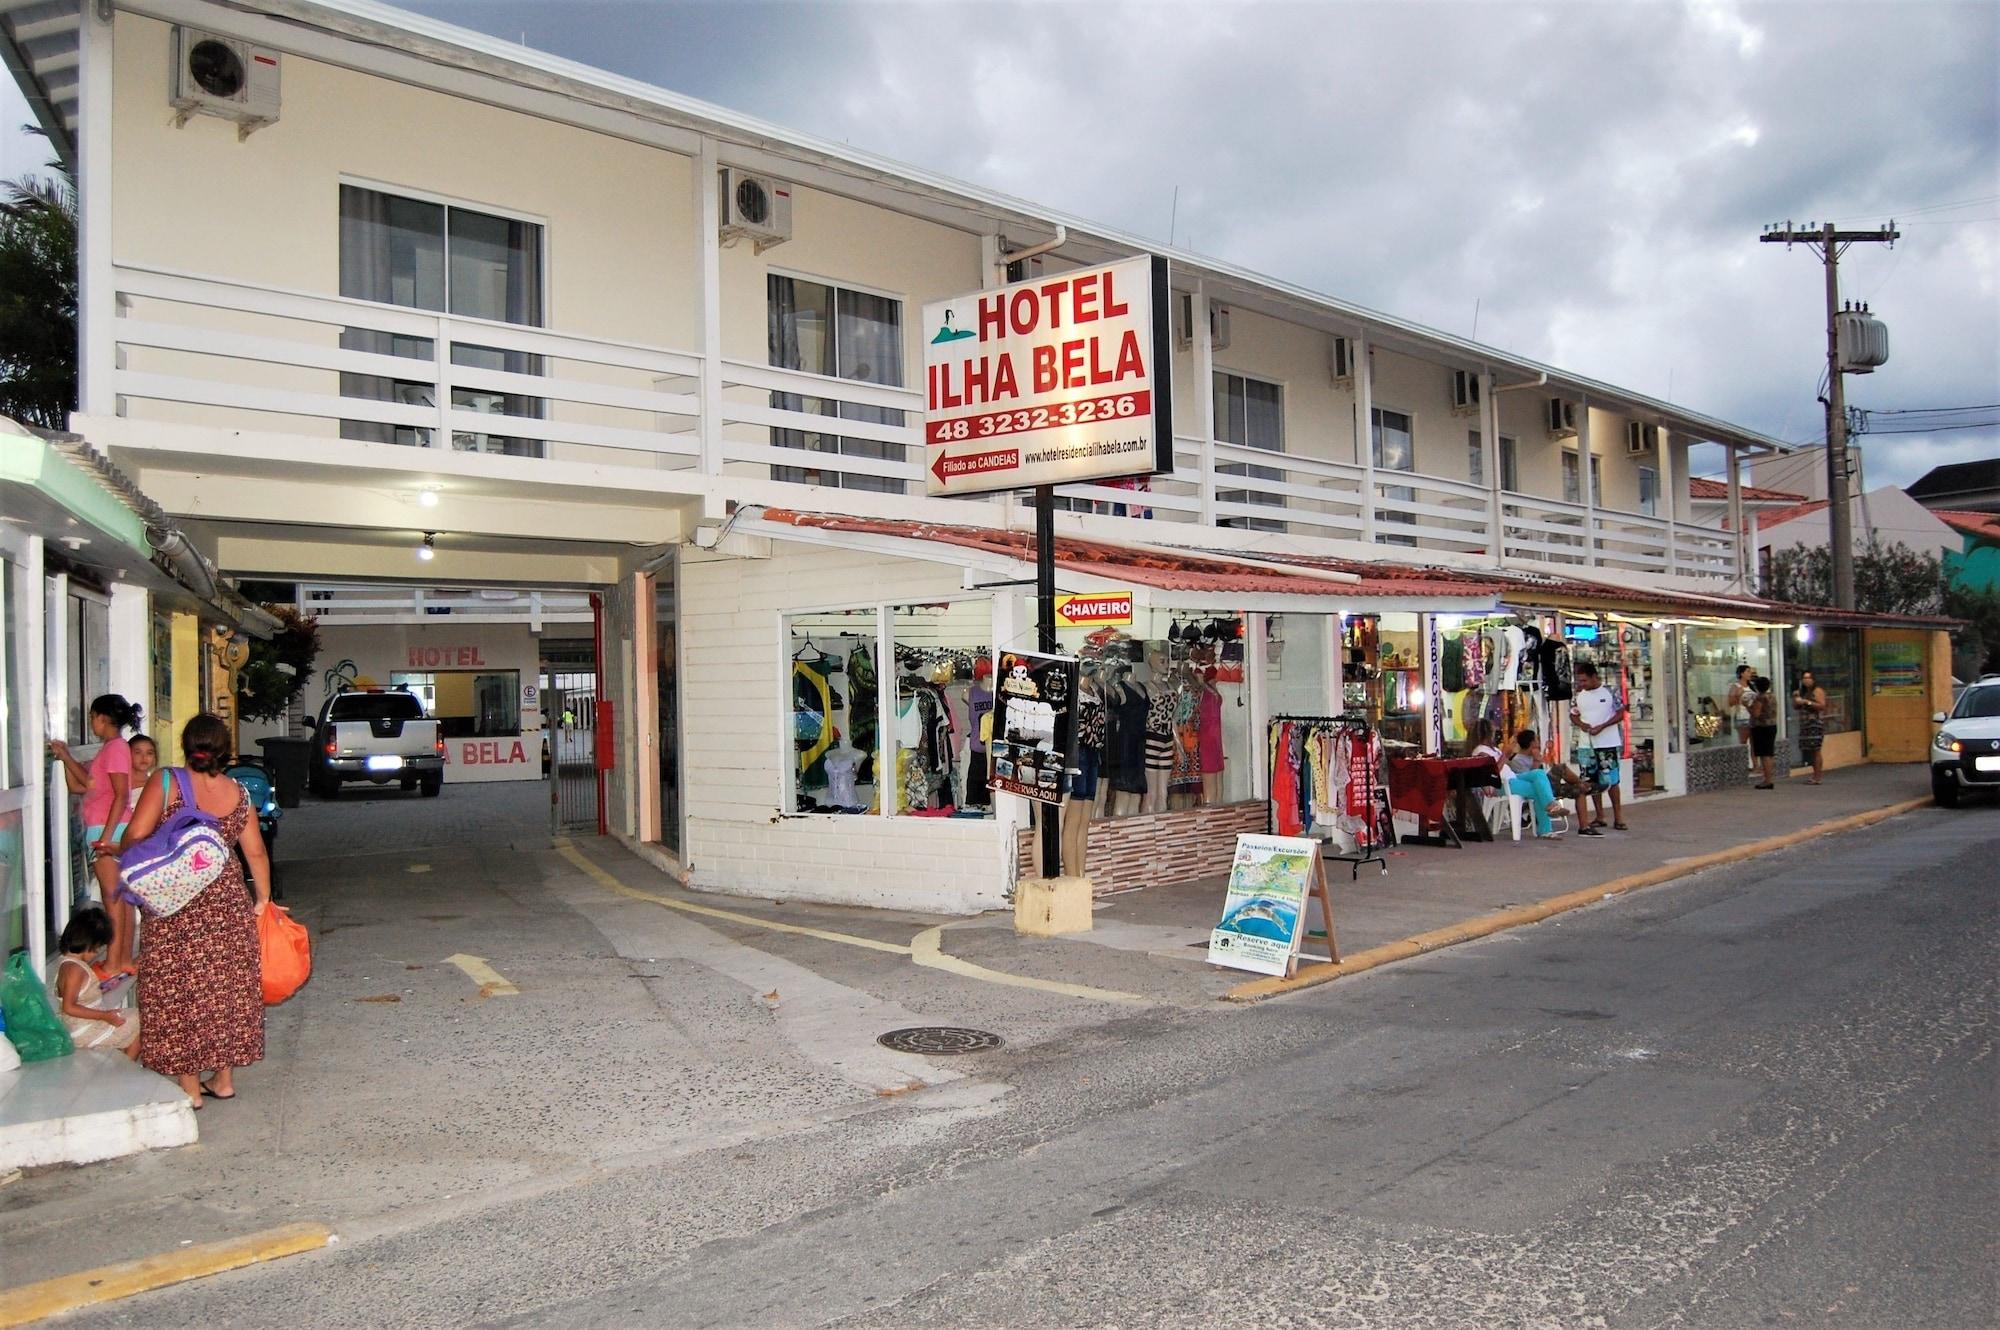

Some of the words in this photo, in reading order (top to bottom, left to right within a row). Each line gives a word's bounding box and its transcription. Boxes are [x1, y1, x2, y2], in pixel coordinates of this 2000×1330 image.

[979, 271, 1128, 342] HOTEL
[928, 352, 1019, 410] ILHA
[1033, 330, 1146, 394] BELA
[935, 420, 969, 441] 48
[978, 396, 1136, 435] 3232-3236
[943, 460, 967, 473] Filiado
[967, 460, 977, 470] ao
[977, 451, 1017, 469] CANDEIAS
[1024, 436, 1147, 465] www.hotelresidencialilhabela.com.br
[1062, 601, 1131, 617] CHAVEIRO
[408, 646, 485, 667] HOTEL
[1430, 618, 1440, 758] TABACARIA
[463, 741, 526, 765] BELA
[1005, 781, 1038, 797] RESERVAS
[1038, 790, 1057, 801] AQUI
[1236, 933, 1269, 946] Reserve
